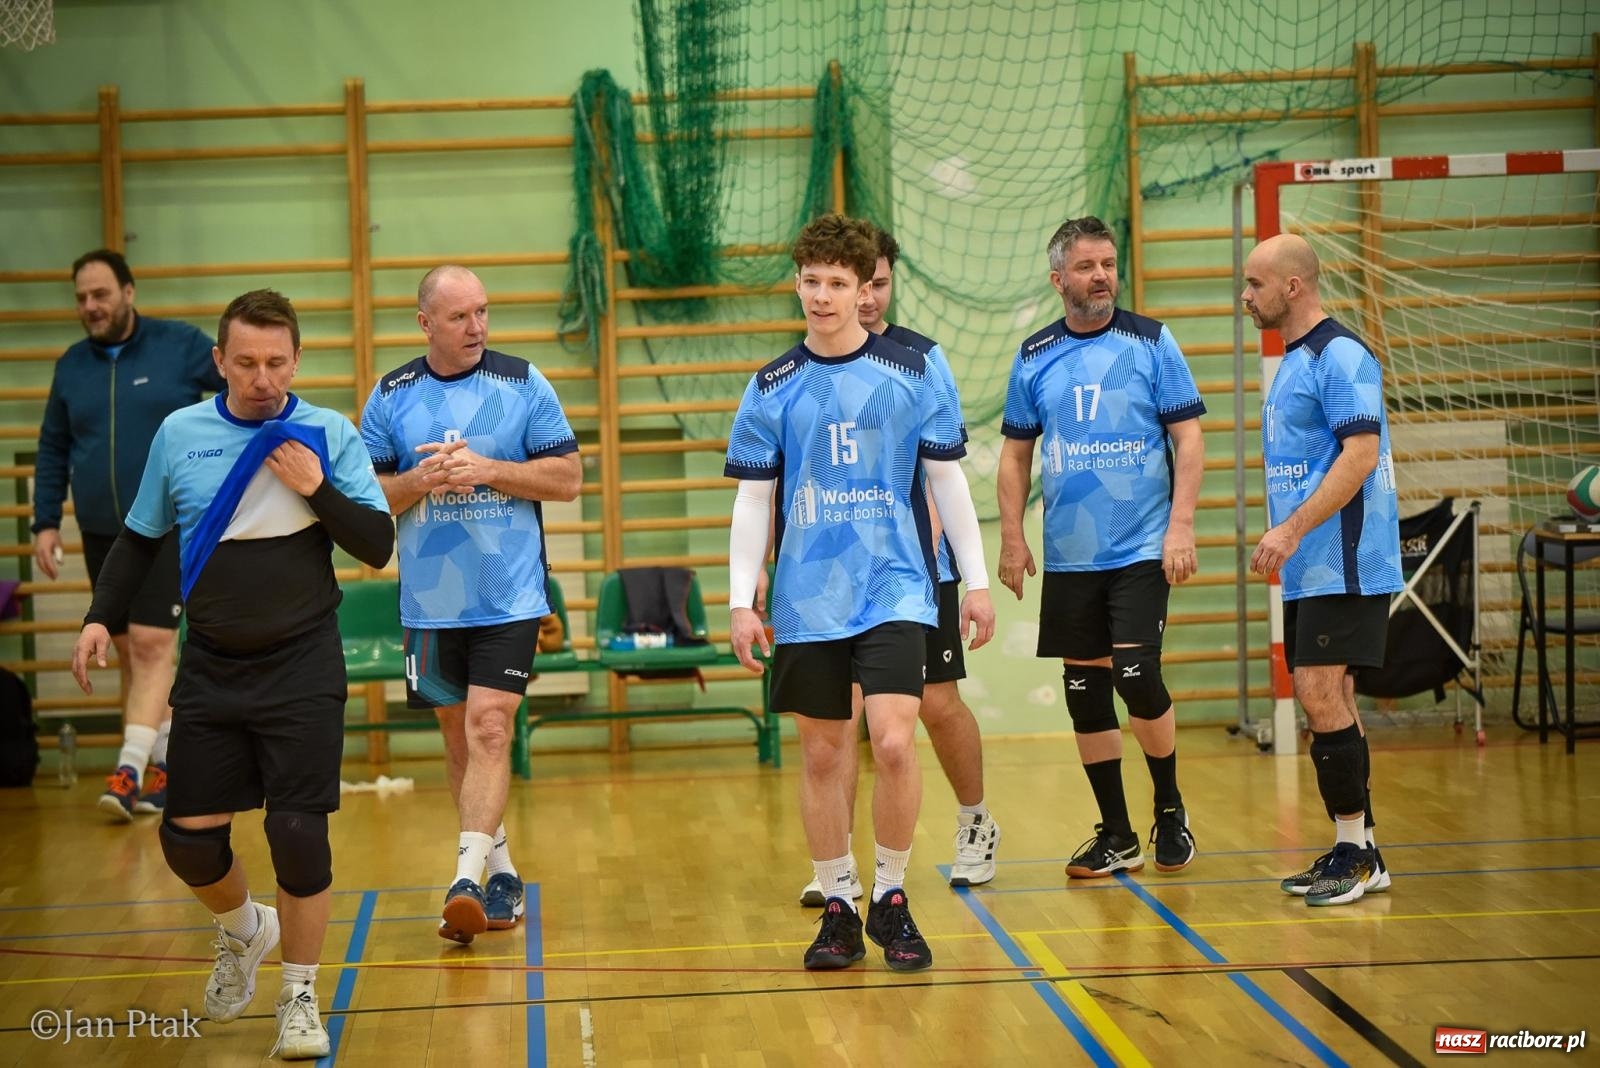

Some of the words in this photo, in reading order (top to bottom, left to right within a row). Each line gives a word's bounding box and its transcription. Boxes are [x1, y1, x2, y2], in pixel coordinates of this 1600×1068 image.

[1341, 163, 1376, 178] sport
[773, 360, 795, 377] VIGO
[1073, 384, 1101, 422] 17
[828, 421, 858, 466] 15
[1066, 436, 1146, 457] Wodociągi
[197, 449, 224, 458] VIGO
[1068, 453, 1148, 471] Raciborskie
[433, 505, 515, 523] Raciborskie
[406, 654, 418, 691] 4
